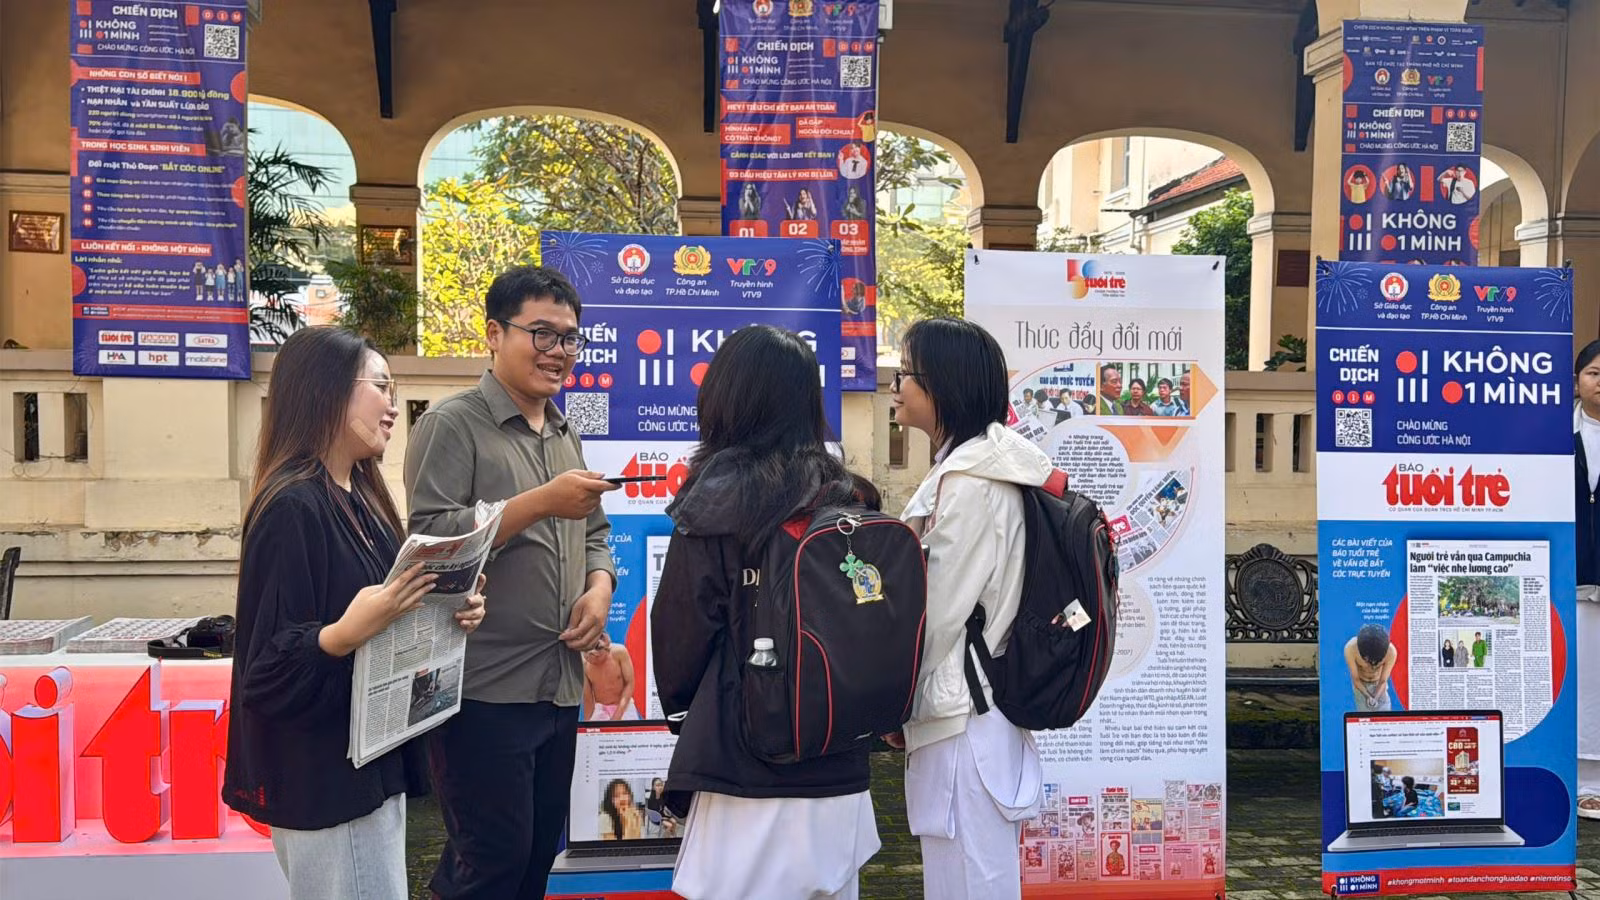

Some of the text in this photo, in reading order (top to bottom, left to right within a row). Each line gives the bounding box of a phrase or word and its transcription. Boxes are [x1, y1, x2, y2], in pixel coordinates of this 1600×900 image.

[113, 3, 177, 18] CHIẾN DỊCH
[96, 19, 136, 29] KHÔNG
[757, 40, 814, 52] CHIẾN DỊCH
[742, 54, 778, 64] KHÔNG
[1373, 106, 1424, 119] CHIẾN DỊCH
[1359, 120, 1392, 130] KHÔNG
[1382, 209, 1456, 229] KHÔNG
[789, 224, 807, 234] 02
[839, 224, 858, 235] 03
[81, 242, 210, 254] LUÔN KẾT NỐI KHÔNG MỘT MÌNH
[611, 276, 655, 287] Sở Giáo dục
[677, 278, 694, 287] Công
[730, 280, 773, 290] Truyền hình
[627, 288, 639, 296] đạo
[642, 288, 653, 296] tạo
[1374, 302, 1412, 311] Sở Giáo dục
[1431, 303, 1446, 312] Công
[1477, 305, 1497, 314] Truyền
[1387, 312, 1399, 320] đạo
[1015, 321, 1182, 355] Thúc đẩy đổi mới
[149, 353, 168, 363] hpt
[1329, 344, 1379, 363] CHIẾN
[1443, 345, 1552, 374] KHÔNG
[1340, 368, 1379, 385] DỊCH
[638, 404, 697, 416] CHÀO MỪNG
[638, 421, 666, 432] CÔNG
[668, 421, 689, 432] ƯỚC
[1397, 420, 1448, 431] CHÀO MỪNG
[1397, 434, 1471, 447] CÔNG ƯỚC HÀ NỘI
[639, 451, 669, 461] BÁO
[1399, 462, 1424, 472] BÁO
[615, 533, 632, 542] CỦA
[1332, 537, 1393, 547] CÁC BÀI VIẾT CỦA
[1333, 548, 1379, 557] BÁO TUỔI TRẺ
[1410, 551, 1531, 564] Người trẻ vẫn qua Campuchia
[1333, 568, 1391, 579] CÓC TRỰC TUYẾN
[1350, 875, 1376, 883] KHÔNG
[1387, 874, 1572, 886] #khongmotminh #toandanchongluadao #niemtinso
